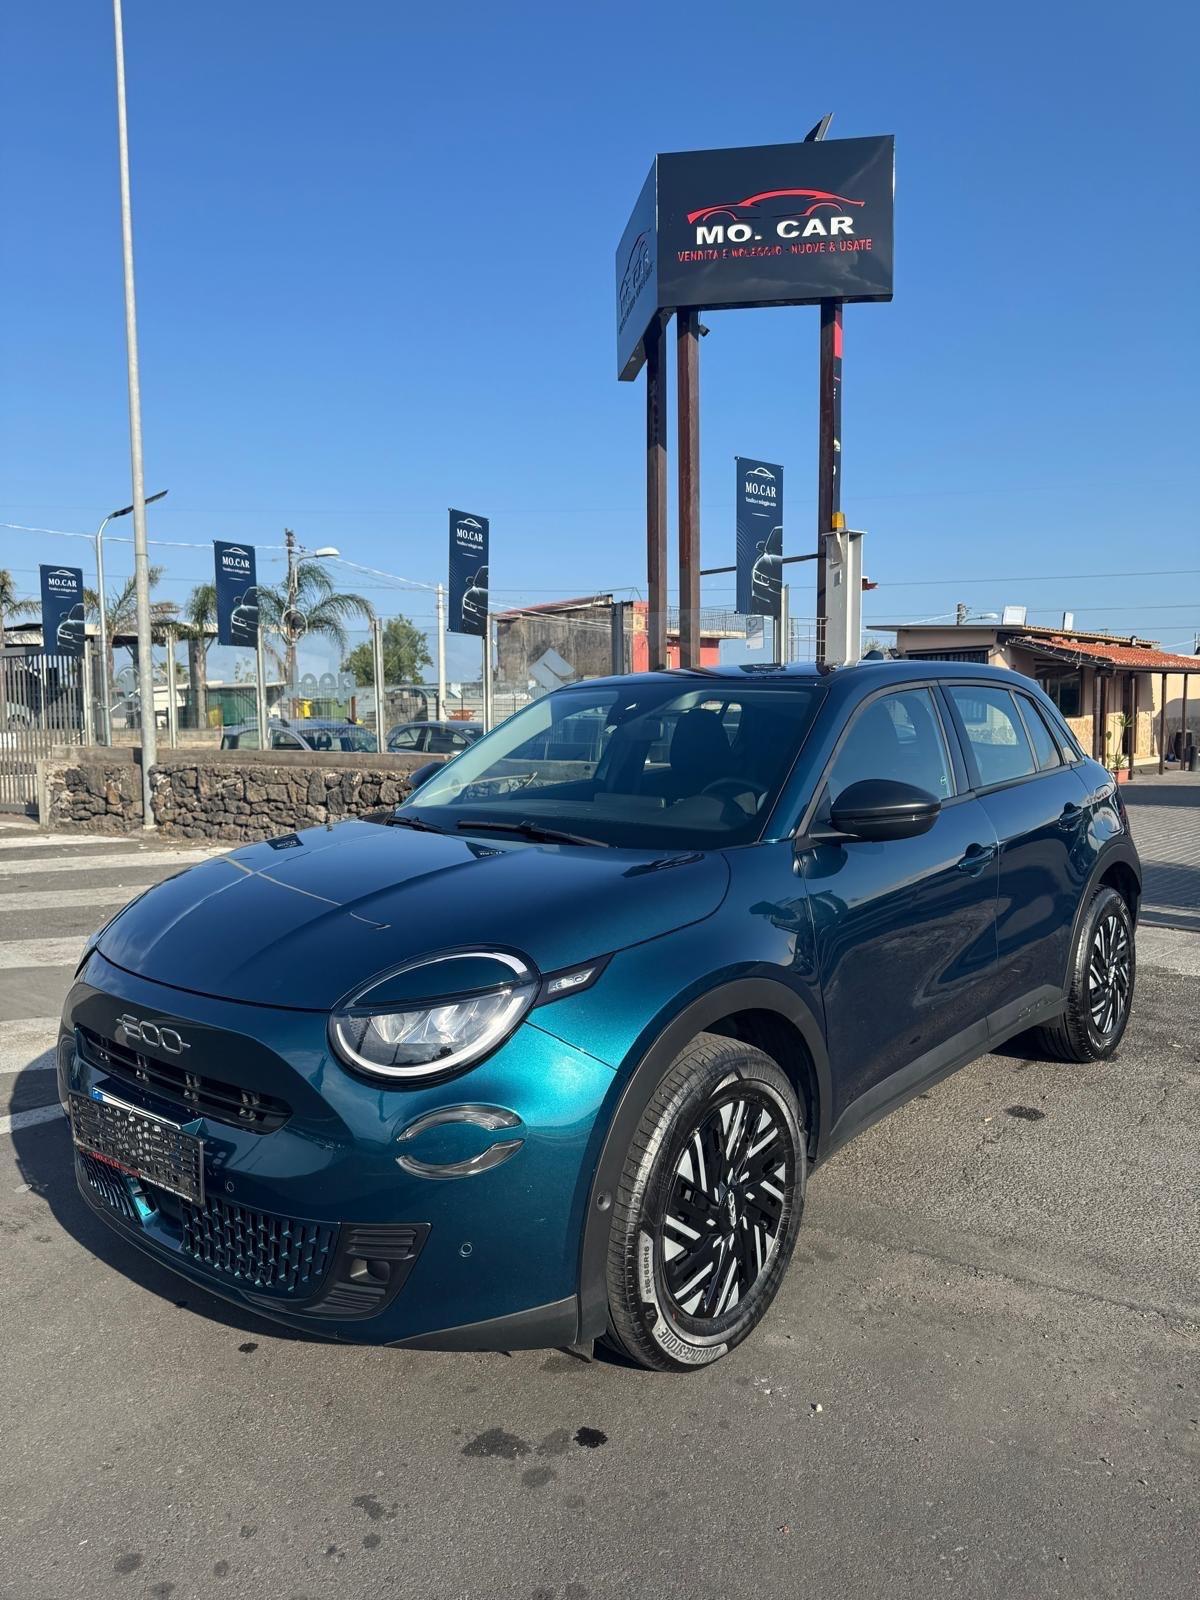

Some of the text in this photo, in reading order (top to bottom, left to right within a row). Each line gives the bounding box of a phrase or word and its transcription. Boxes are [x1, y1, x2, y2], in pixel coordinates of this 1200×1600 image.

[696, 216, 855, 245] MO. CAR
[678, 249, 719, 263] VENDITA
[791, 241, 826, 255] NUOVE
[829, 240, 836, 252] &
[839, 239, 872, 252] USATE
[745, 481, 777, 498] MO.CAR
[456, 528, 484, 543] MO.CAR
[222, 555, 251, 569] MO.CAR
[48, 577, 78, 588] MO.CAR
